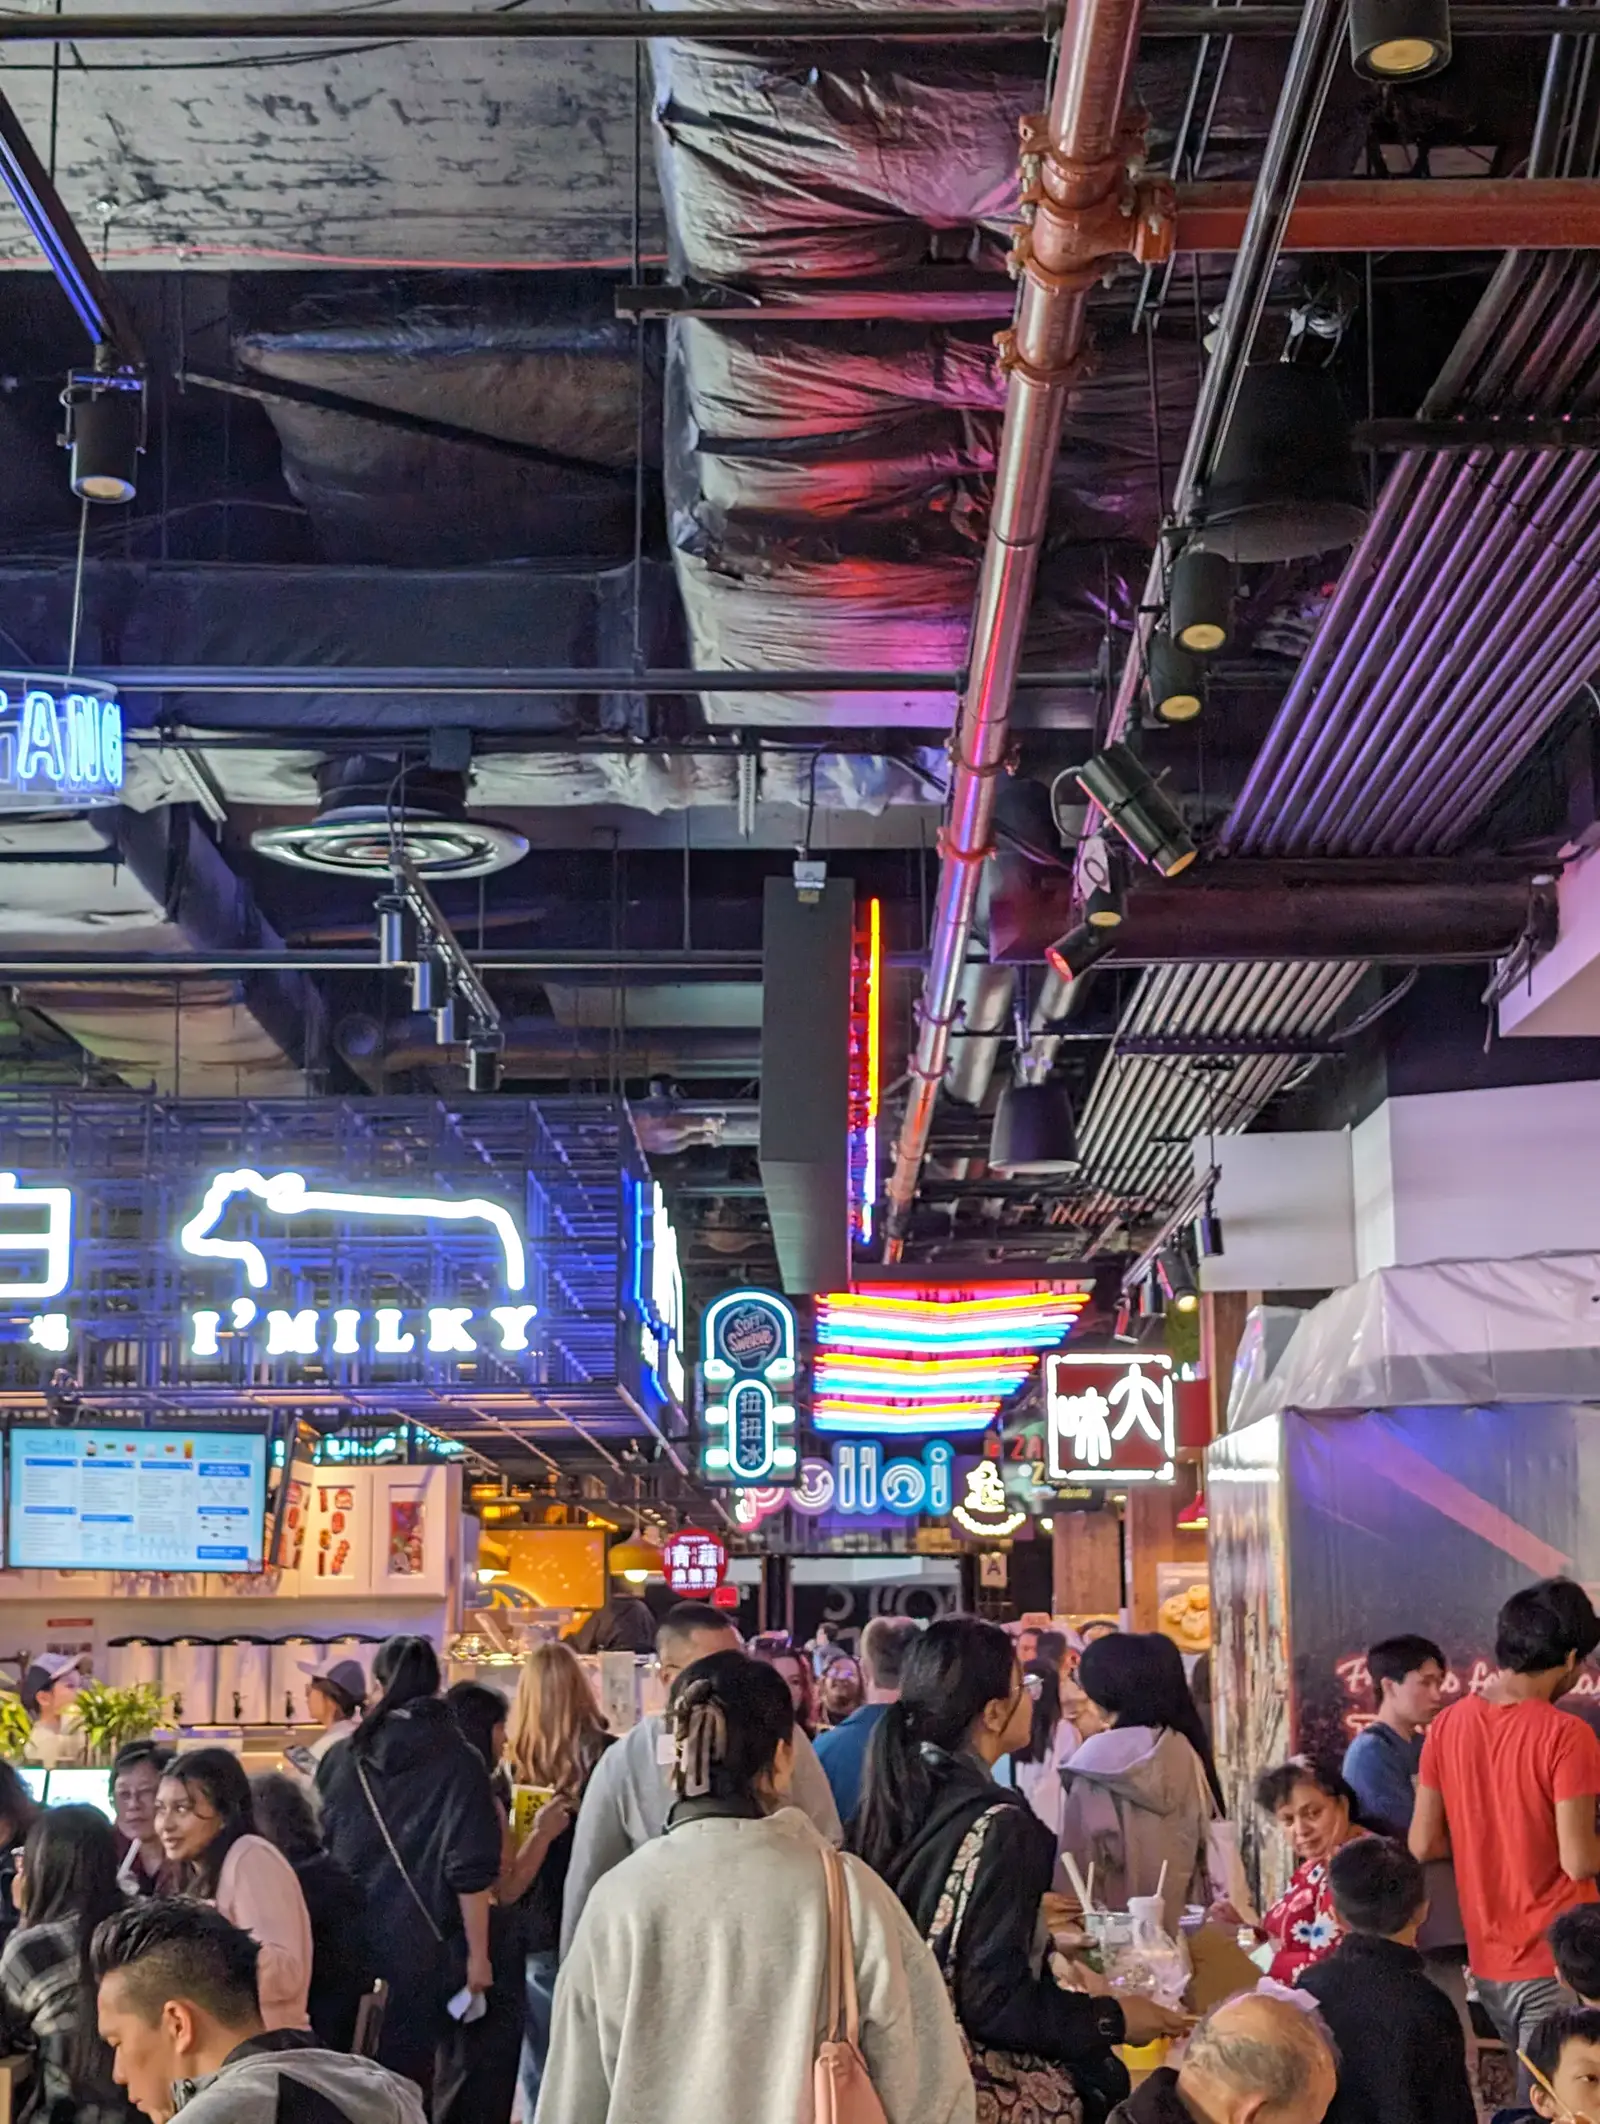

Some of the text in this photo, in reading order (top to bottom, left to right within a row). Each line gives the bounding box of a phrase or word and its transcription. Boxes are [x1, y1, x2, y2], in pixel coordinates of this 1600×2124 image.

[0, 690, 123, 788] ANG
[191, 1297, 537, 1355] I'MILKY
[740, 1391, 763, 1466] 扭扭冰
